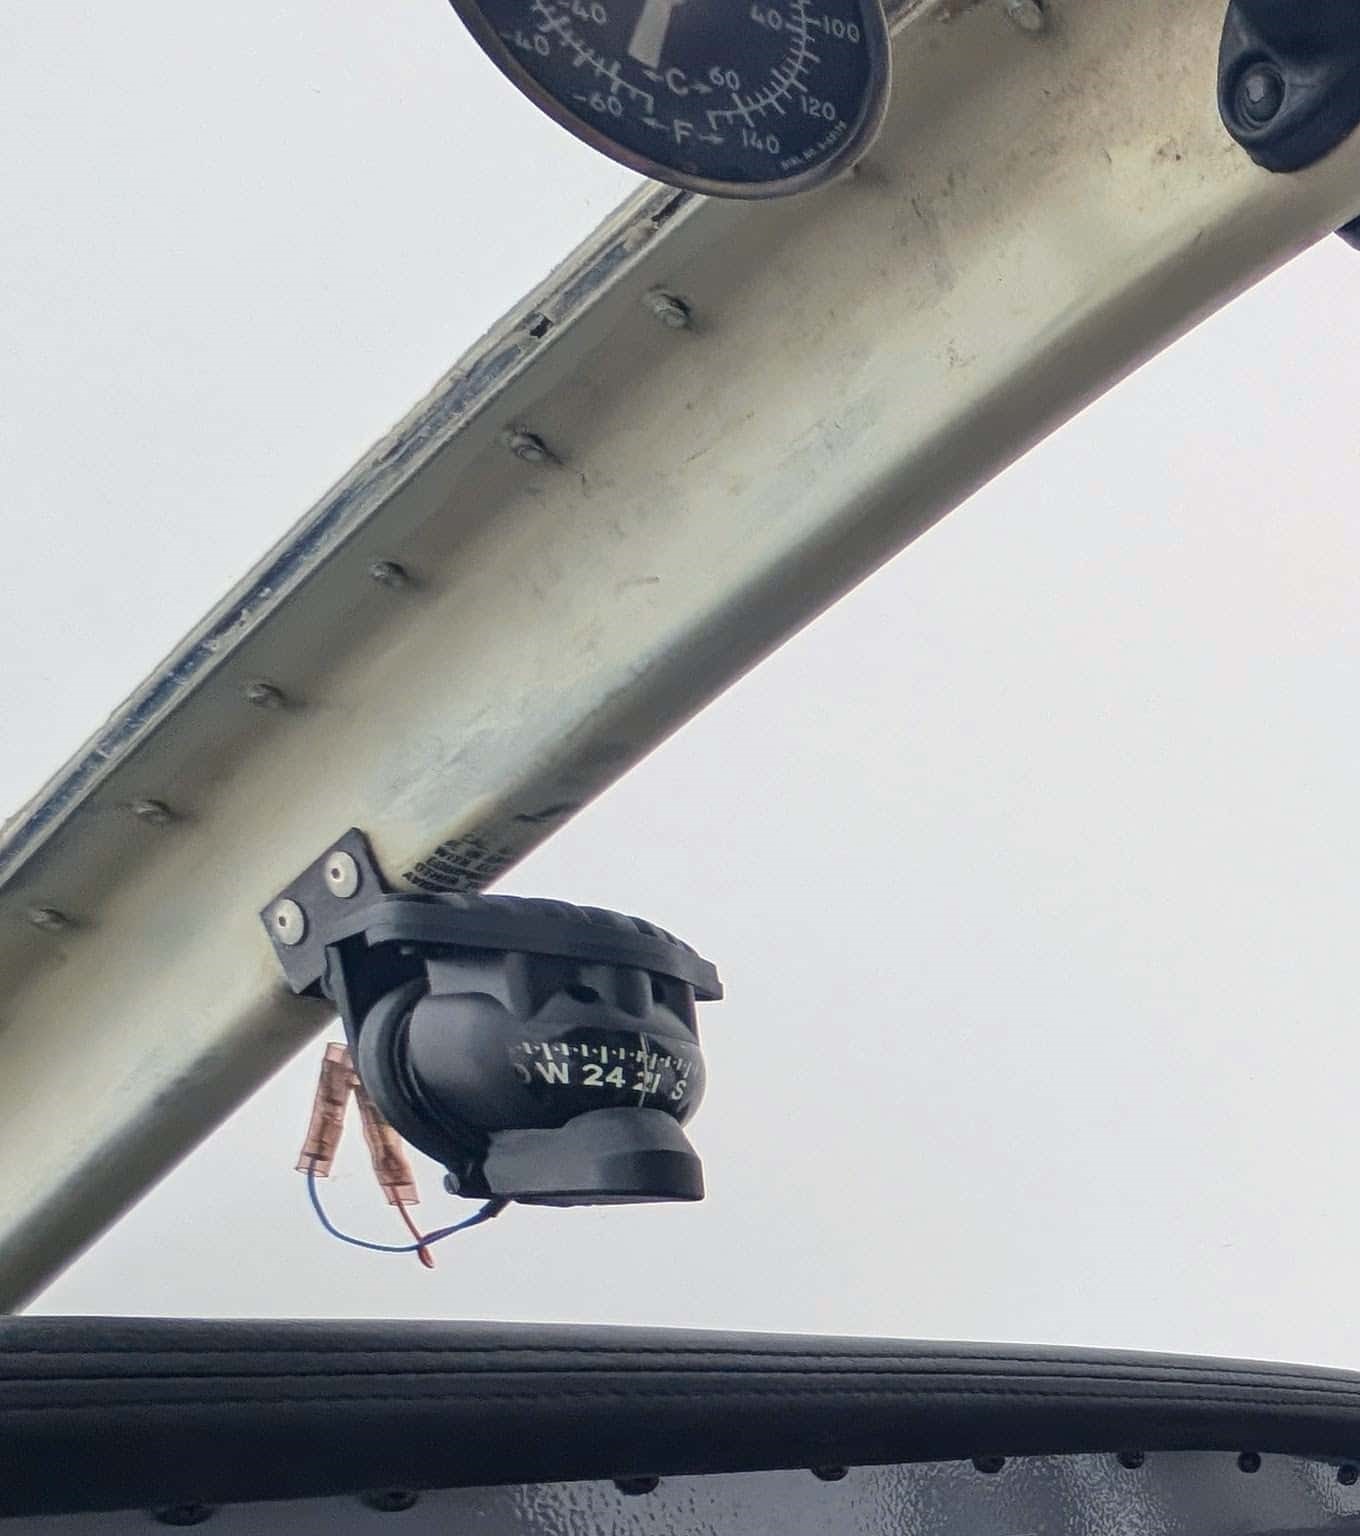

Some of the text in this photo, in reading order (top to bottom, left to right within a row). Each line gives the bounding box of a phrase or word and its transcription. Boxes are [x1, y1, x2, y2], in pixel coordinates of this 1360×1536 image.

[750, 9, 784, 33] 40
[824, 16, 861, 43] 100
[665, 67, 689, 95] C
[711, 68, 741, 92] 60
[573, 94, 624, 118] -60
[803, 94, 837, 121] 120
[673, 121, 694, 145] F
[742, 127, 780, 155] 140
[535, 1062, 570, 1085] W
[582, 1063, 627, 1089] 24
[671, 1079, 688, 1101] S
